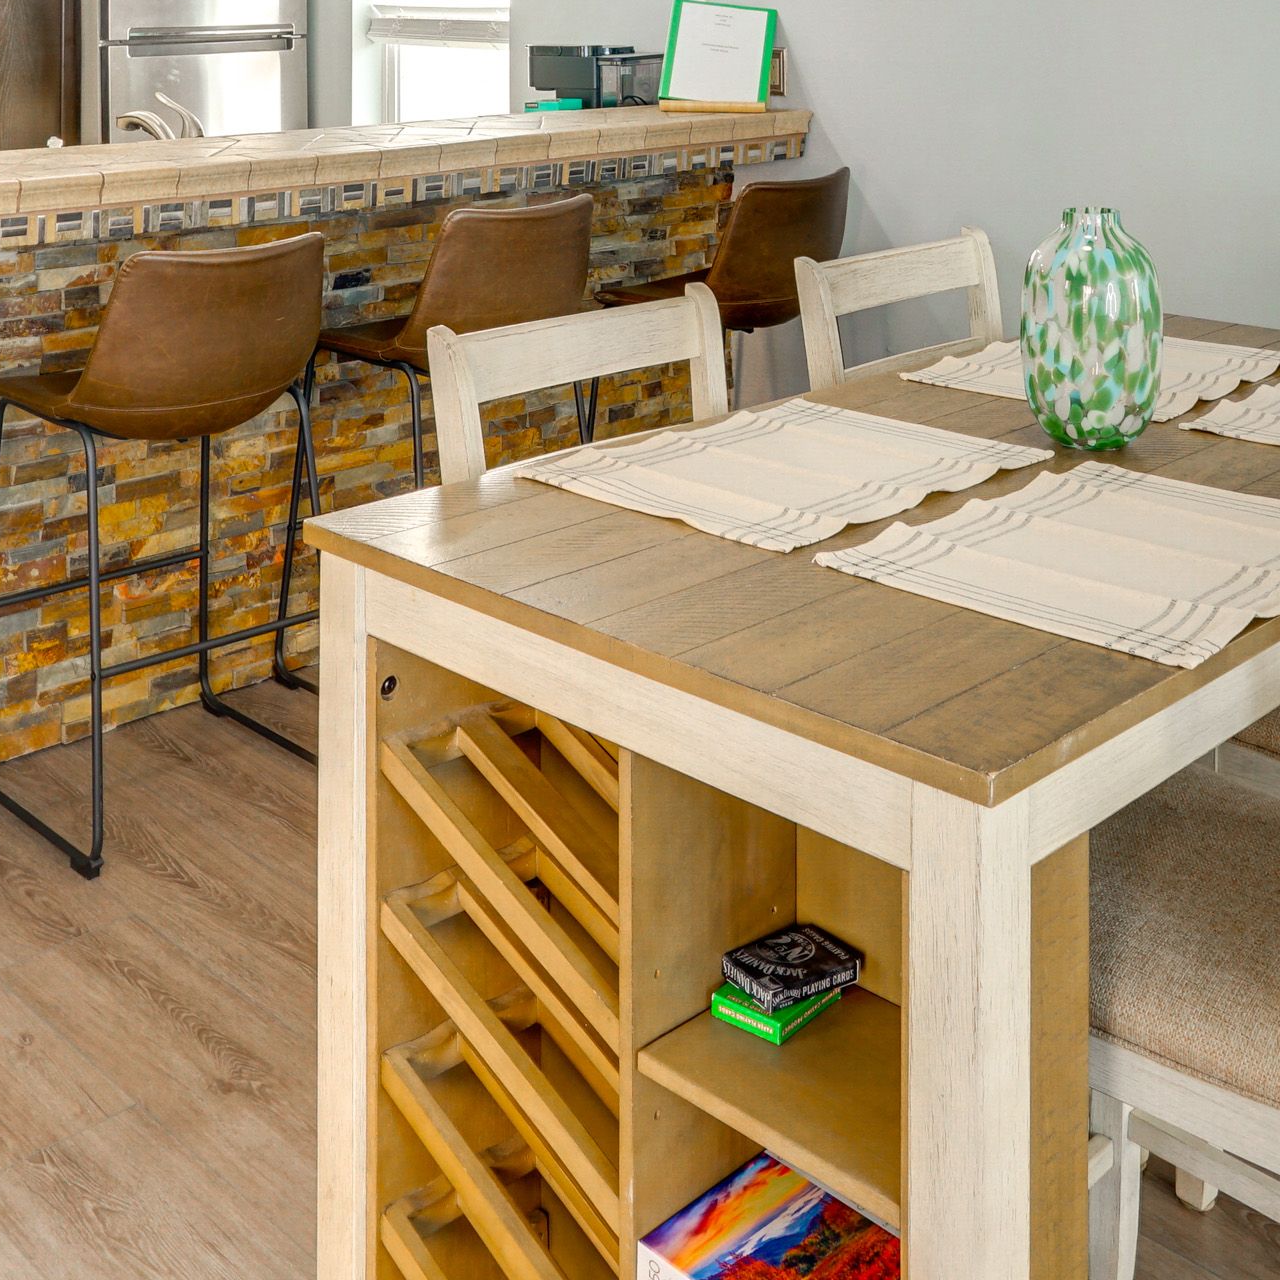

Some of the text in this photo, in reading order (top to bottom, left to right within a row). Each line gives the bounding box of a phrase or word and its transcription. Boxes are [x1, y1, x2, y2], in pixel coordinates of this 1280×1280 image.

[723, 960, 752, 993] DANIEL'S
[775, 967, 807, 979] JACK
[802, 977, 831, 997] PLAYING
[833, 969, 855, 985] CARDS
[752, 981, 770, 1008] JACK
